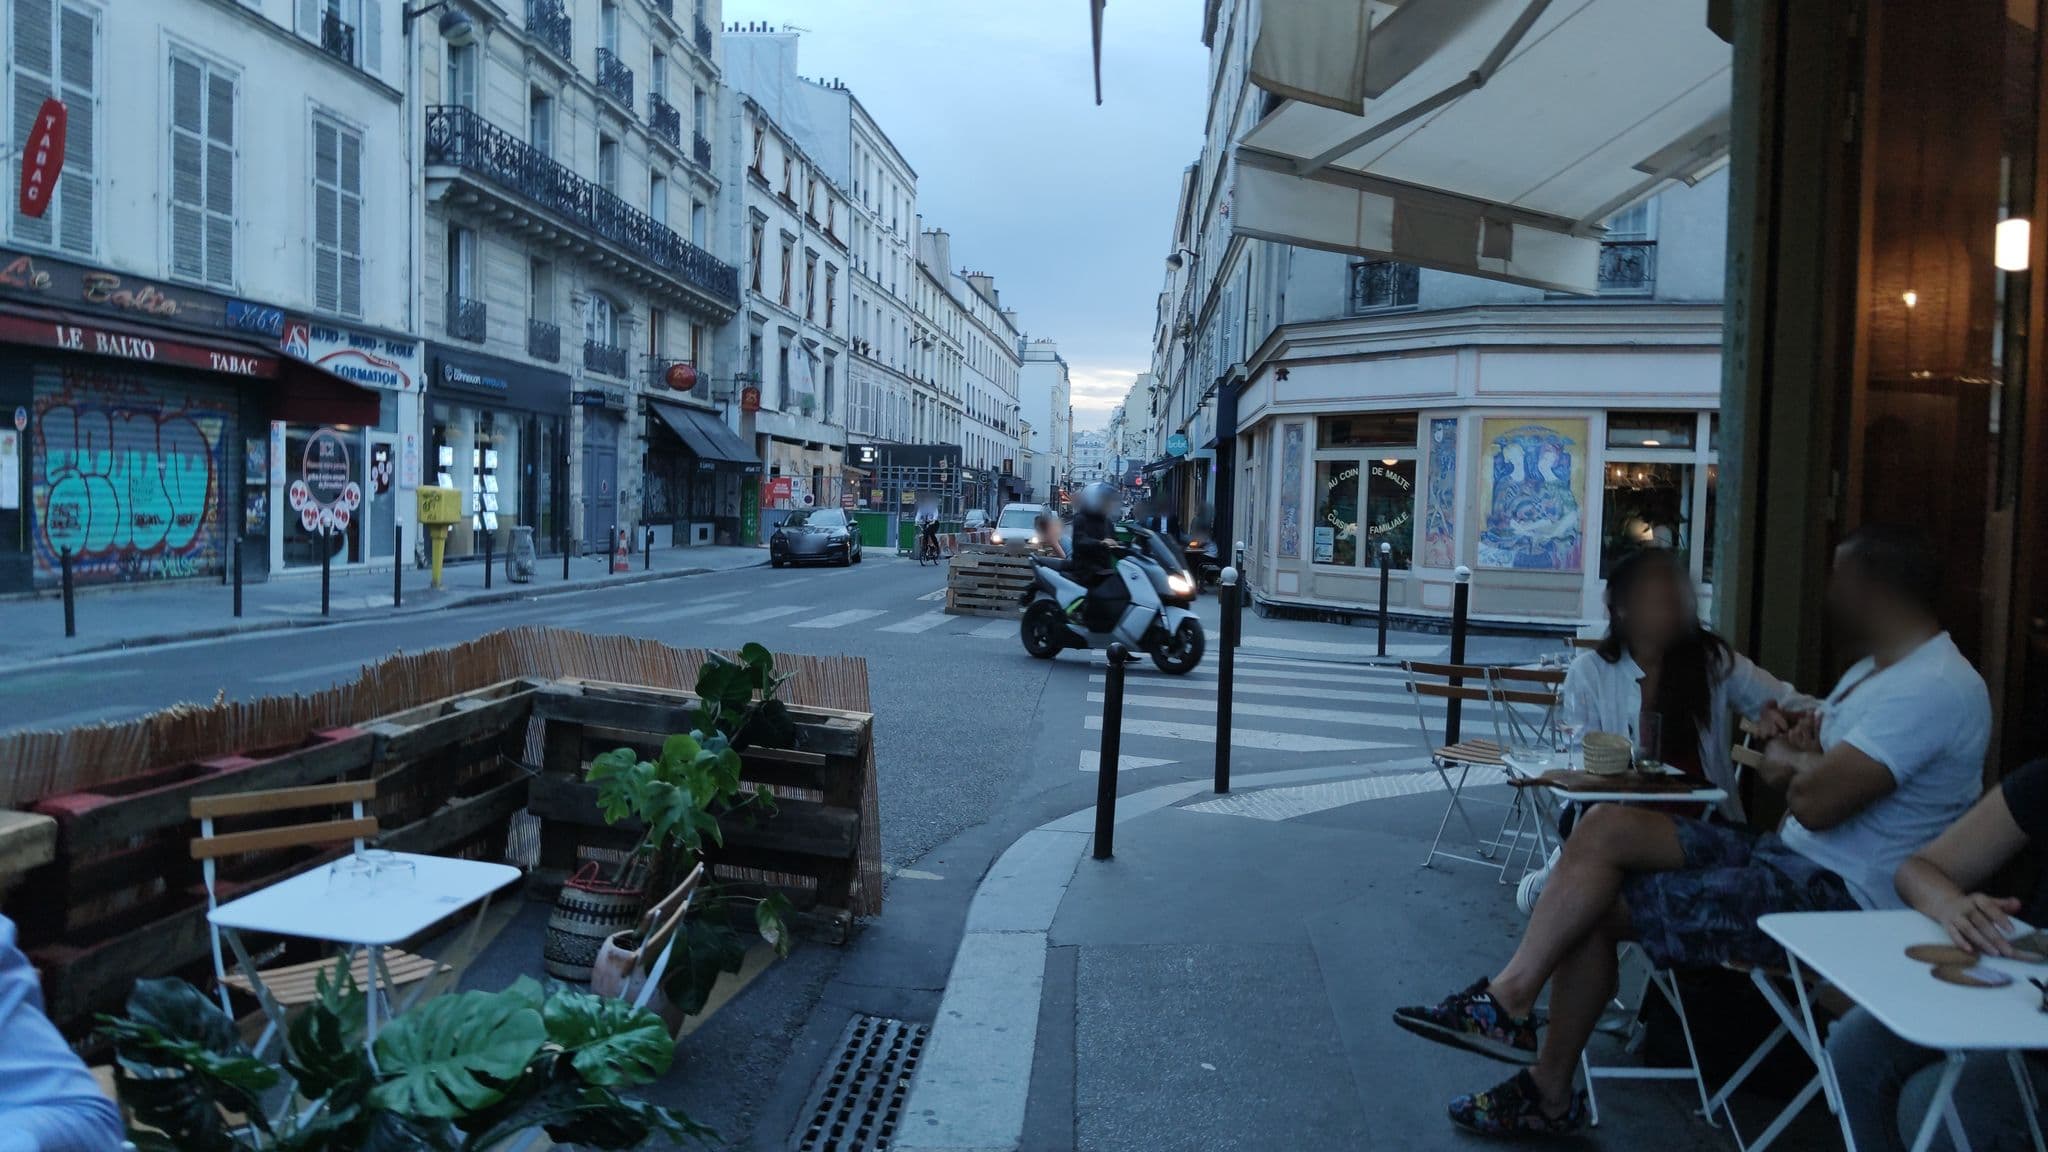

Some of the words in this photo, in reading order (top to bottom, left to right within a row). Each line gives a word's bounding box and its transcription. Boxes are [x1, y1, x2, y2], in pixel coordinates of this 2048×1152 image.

[27, 115, 57, 201] TABAC
[0, 255, 52, 290] Le
[56, 326, 84, 350] LE
[96, 332, 155, 360] BALTO
[310, 325, 340, 344] AUTO
[348, 332, 378, 351] MOTO
[210, 352, 258, 376] TABAC
[334, 365, 398, 386] FORMATION
[1327, 478, 1338, 491] AU
[1339, 468, 1359, 481] COIN
[1372, 467, 1383, 476] DE
[1385, 470, 1411, 491] MALTE
[1369, 511, 1409, 534] FAMILIALE
